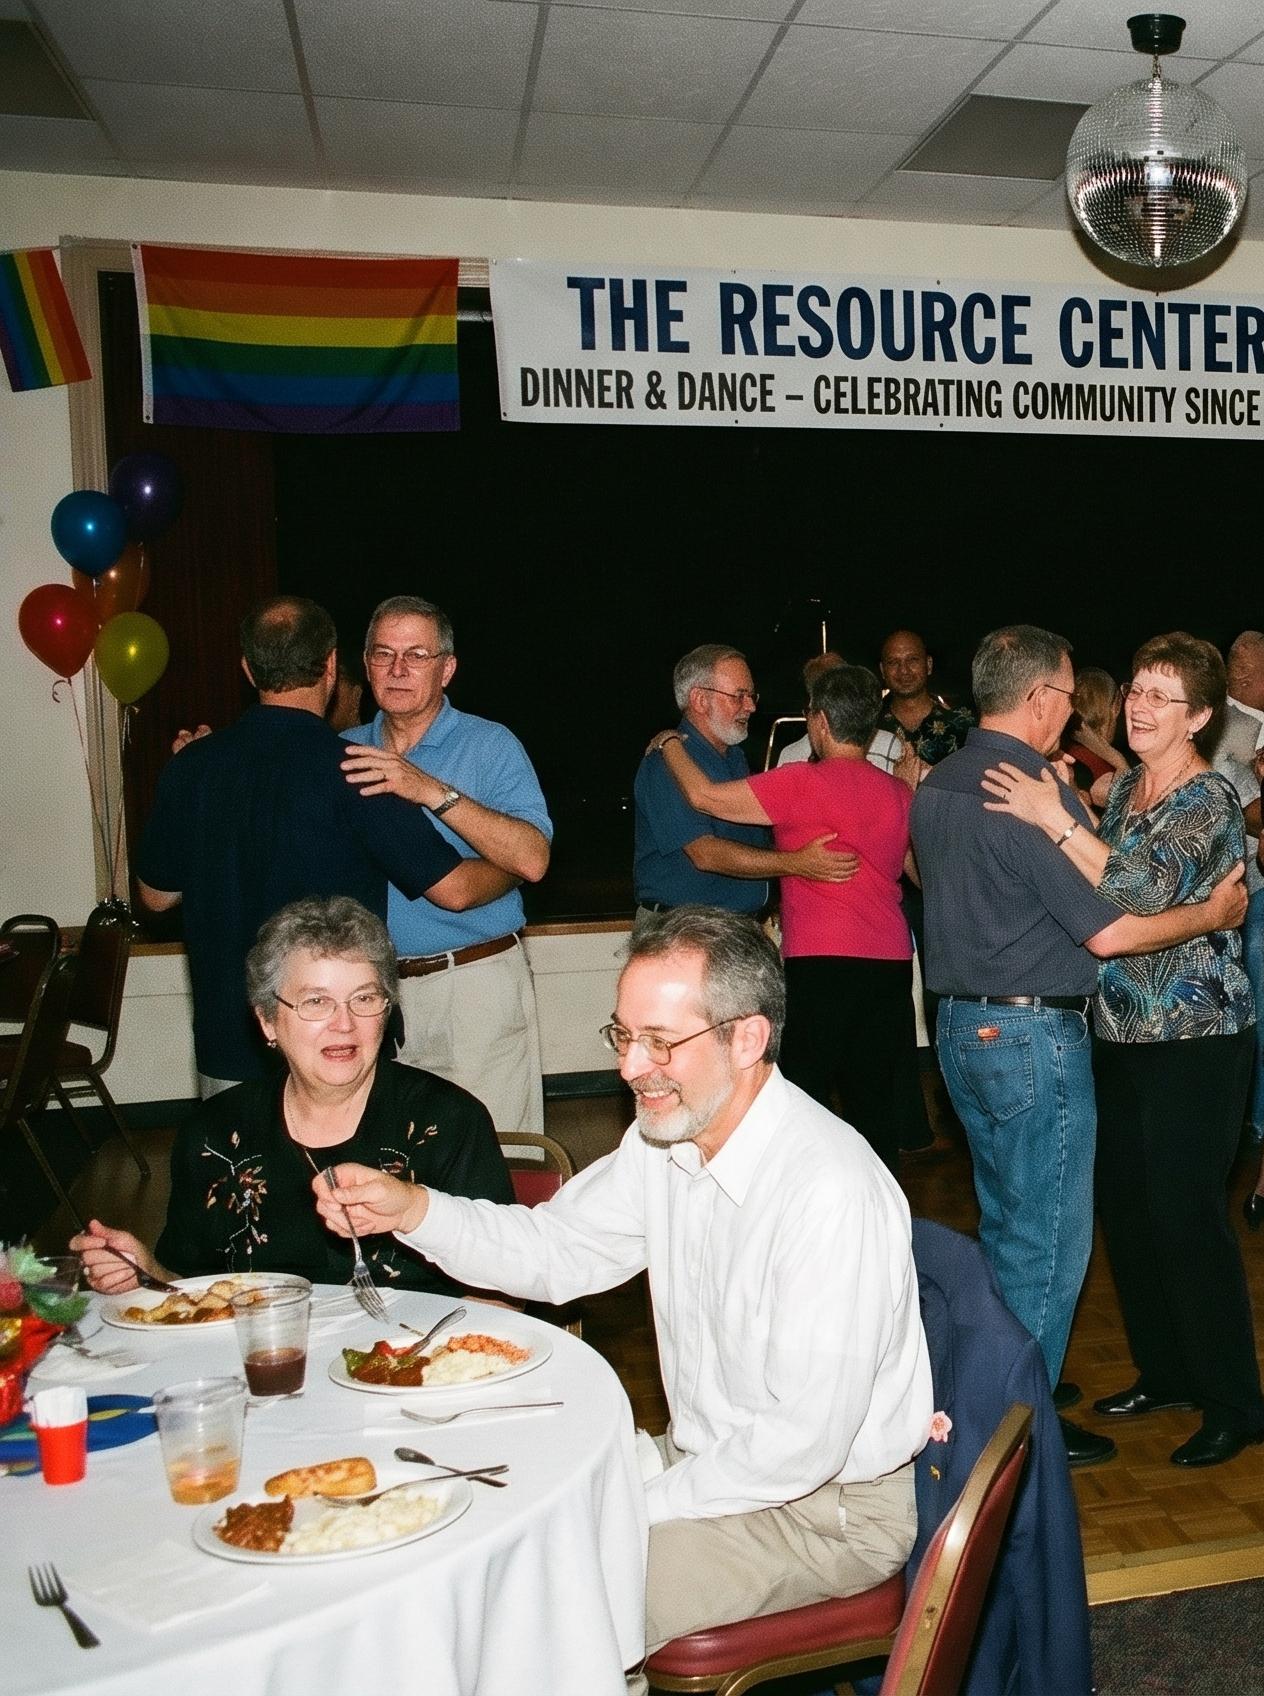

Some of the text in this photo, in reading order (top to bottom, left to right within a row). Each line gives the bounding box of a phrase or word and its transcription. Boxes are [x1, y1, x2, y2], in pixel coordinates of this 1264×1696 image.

[566, 275, 691, 354] THE
[719, 281, 1033, 366] RESOURCE
[520, 366, 635, 410] DINNER
[644, 369, 668, 411] &
[677, 370, 776, 413] DANCE
[813, 374, 1003, 419] CELEBRATING
[1012, 380, 1177, 424] COMMUNITY
[1184, 386, 1261, 427] SINCE
